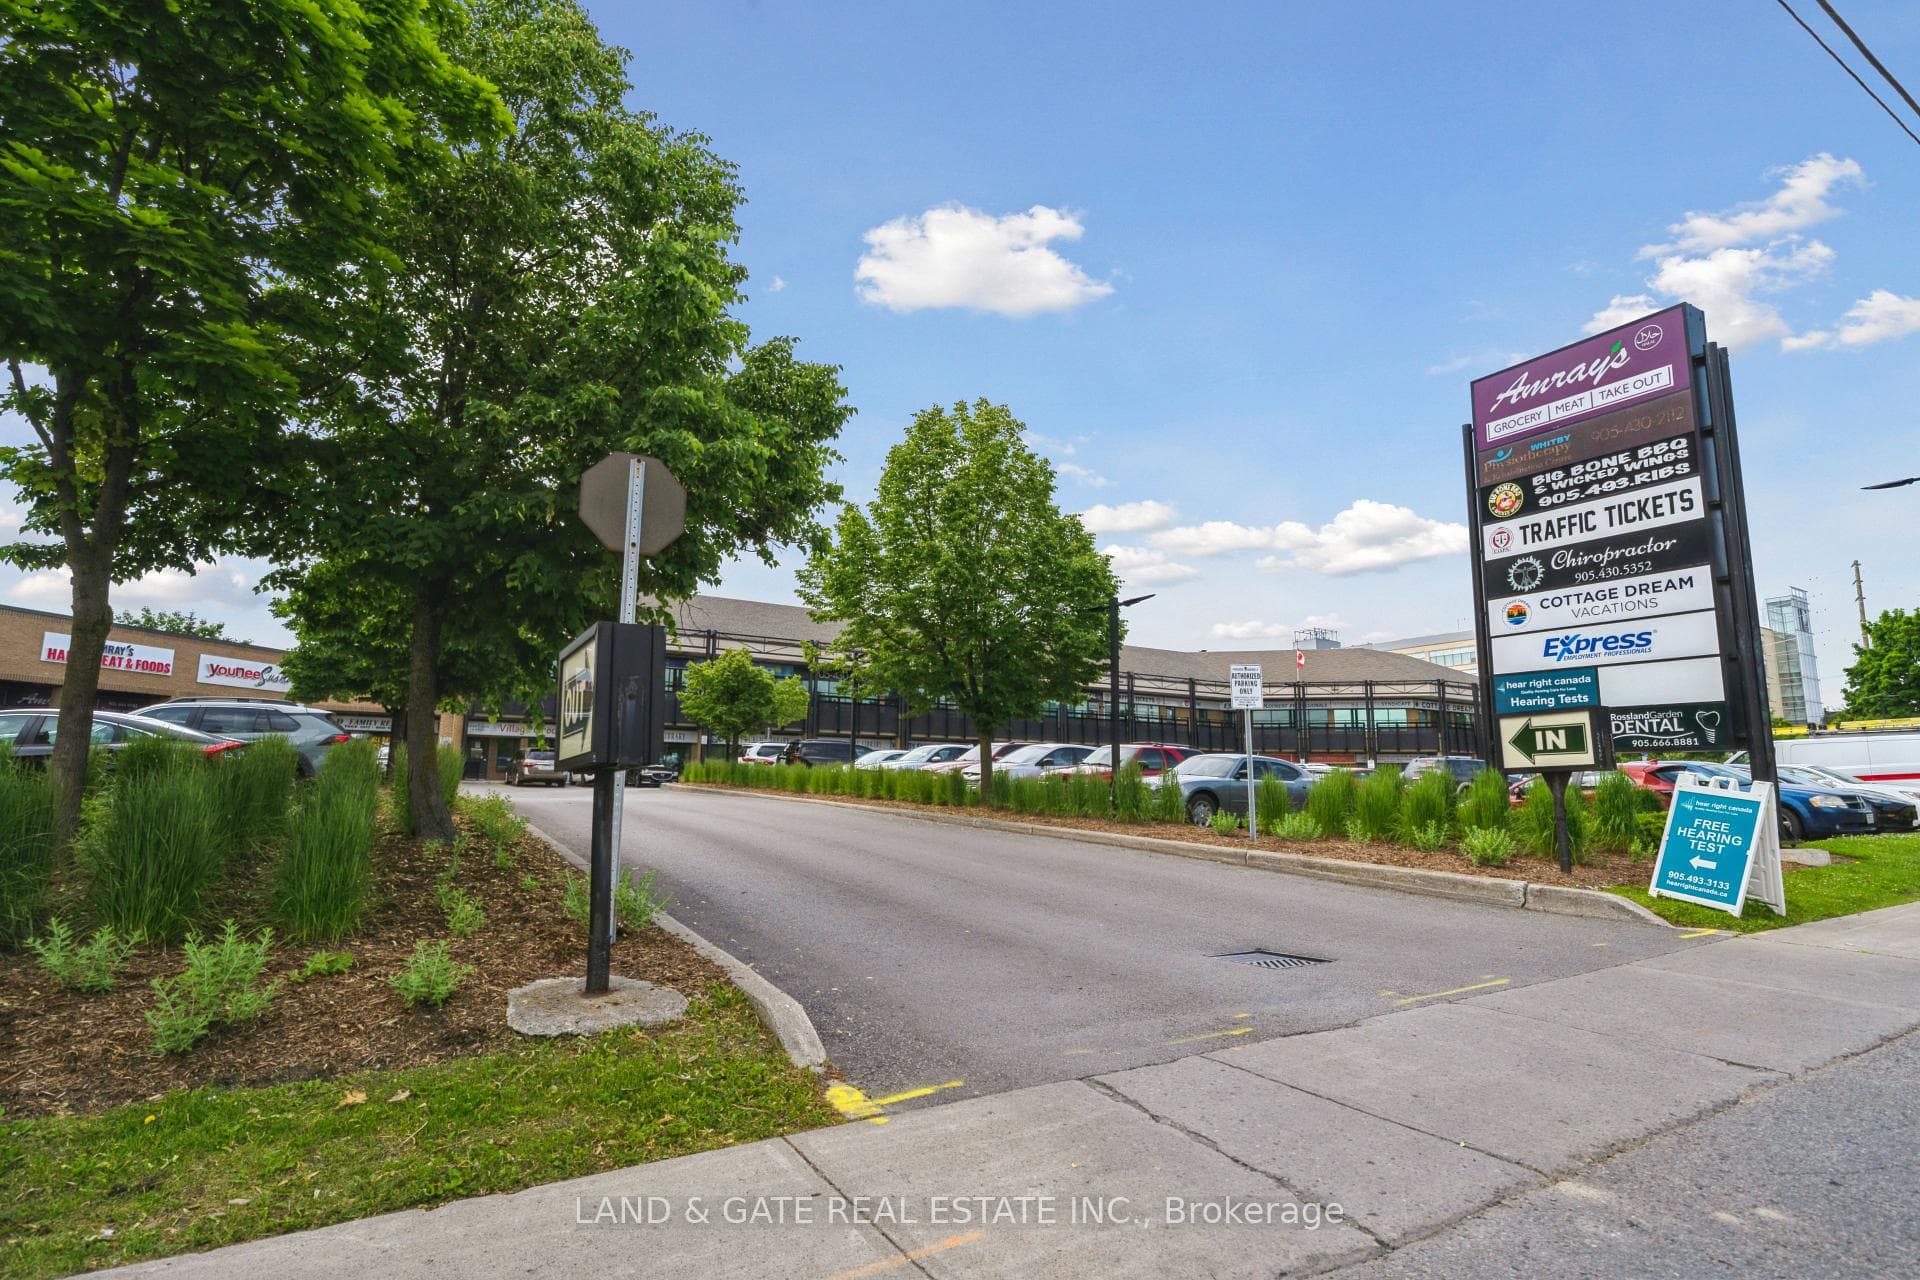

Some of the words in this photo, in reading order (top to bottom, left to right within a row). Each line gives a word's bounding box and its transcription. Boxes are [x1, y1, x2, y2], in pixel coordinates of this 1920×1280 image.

[1493, 410, 1542, 433] GROCERY
[1555, 397, 1585, 414] MEAT
[1598, 385, 1629, 400] TAKE
[1633, 372, 1662, 388] OUT
[1530, 434, 1571, 451] WHITBY
[1532, 471, 1566, 486] BIG
[1571, 452, 1632, 476] BONE
[1637, 438, 1688, 457] BBQ
[1534, 485, 1547, 494] &
[1551, 467, 1619, 490] WICKED
[1624, 449, 1689, 472] WINGS
[1538, 462, 1691, 507] 905.493.RIBS
[1519, 510, 1597, 545] TRAFFIC
[1604, 488, 1694, 527] TICKETS
[1551, 537, 1677, 569] Chiropractor
[1574, 561, 1652, 583] 905.430.5352
[1540, 588, 1618, 609] COTTAGE
[1625, 575, 1694, 596] DREAM
[1571, 597, 1658, 619] VACATIONS
[101, 655, 122, 668] EAT
[136, 660, 171, 673] FOODS
[1563, 652, 1601, 661] EMPLOYMENT
[1604, 647, 1652, 657] PROFESSIONALS
[1506, 681, 1527, 689] hear
[1529, 679, 1552, 688] right
[1554, 675, 1591, 685] canada
[1510, 696, 1555, 707] Hearing
[1558, 693, 1589, 704] Tests
[1611, 718, 1684, 734] DENTAL
[1535, 729, 1567, 750] IN
[1632, 738, 1699, 747] 905.666.8881
[1693, 818, 1731, 833] FREE
[1677, 826, 1743, 846] HEARING
[1689, 839, 1725, 854] TEST
[1668, 870, 1730, 890] 905.493.3133
